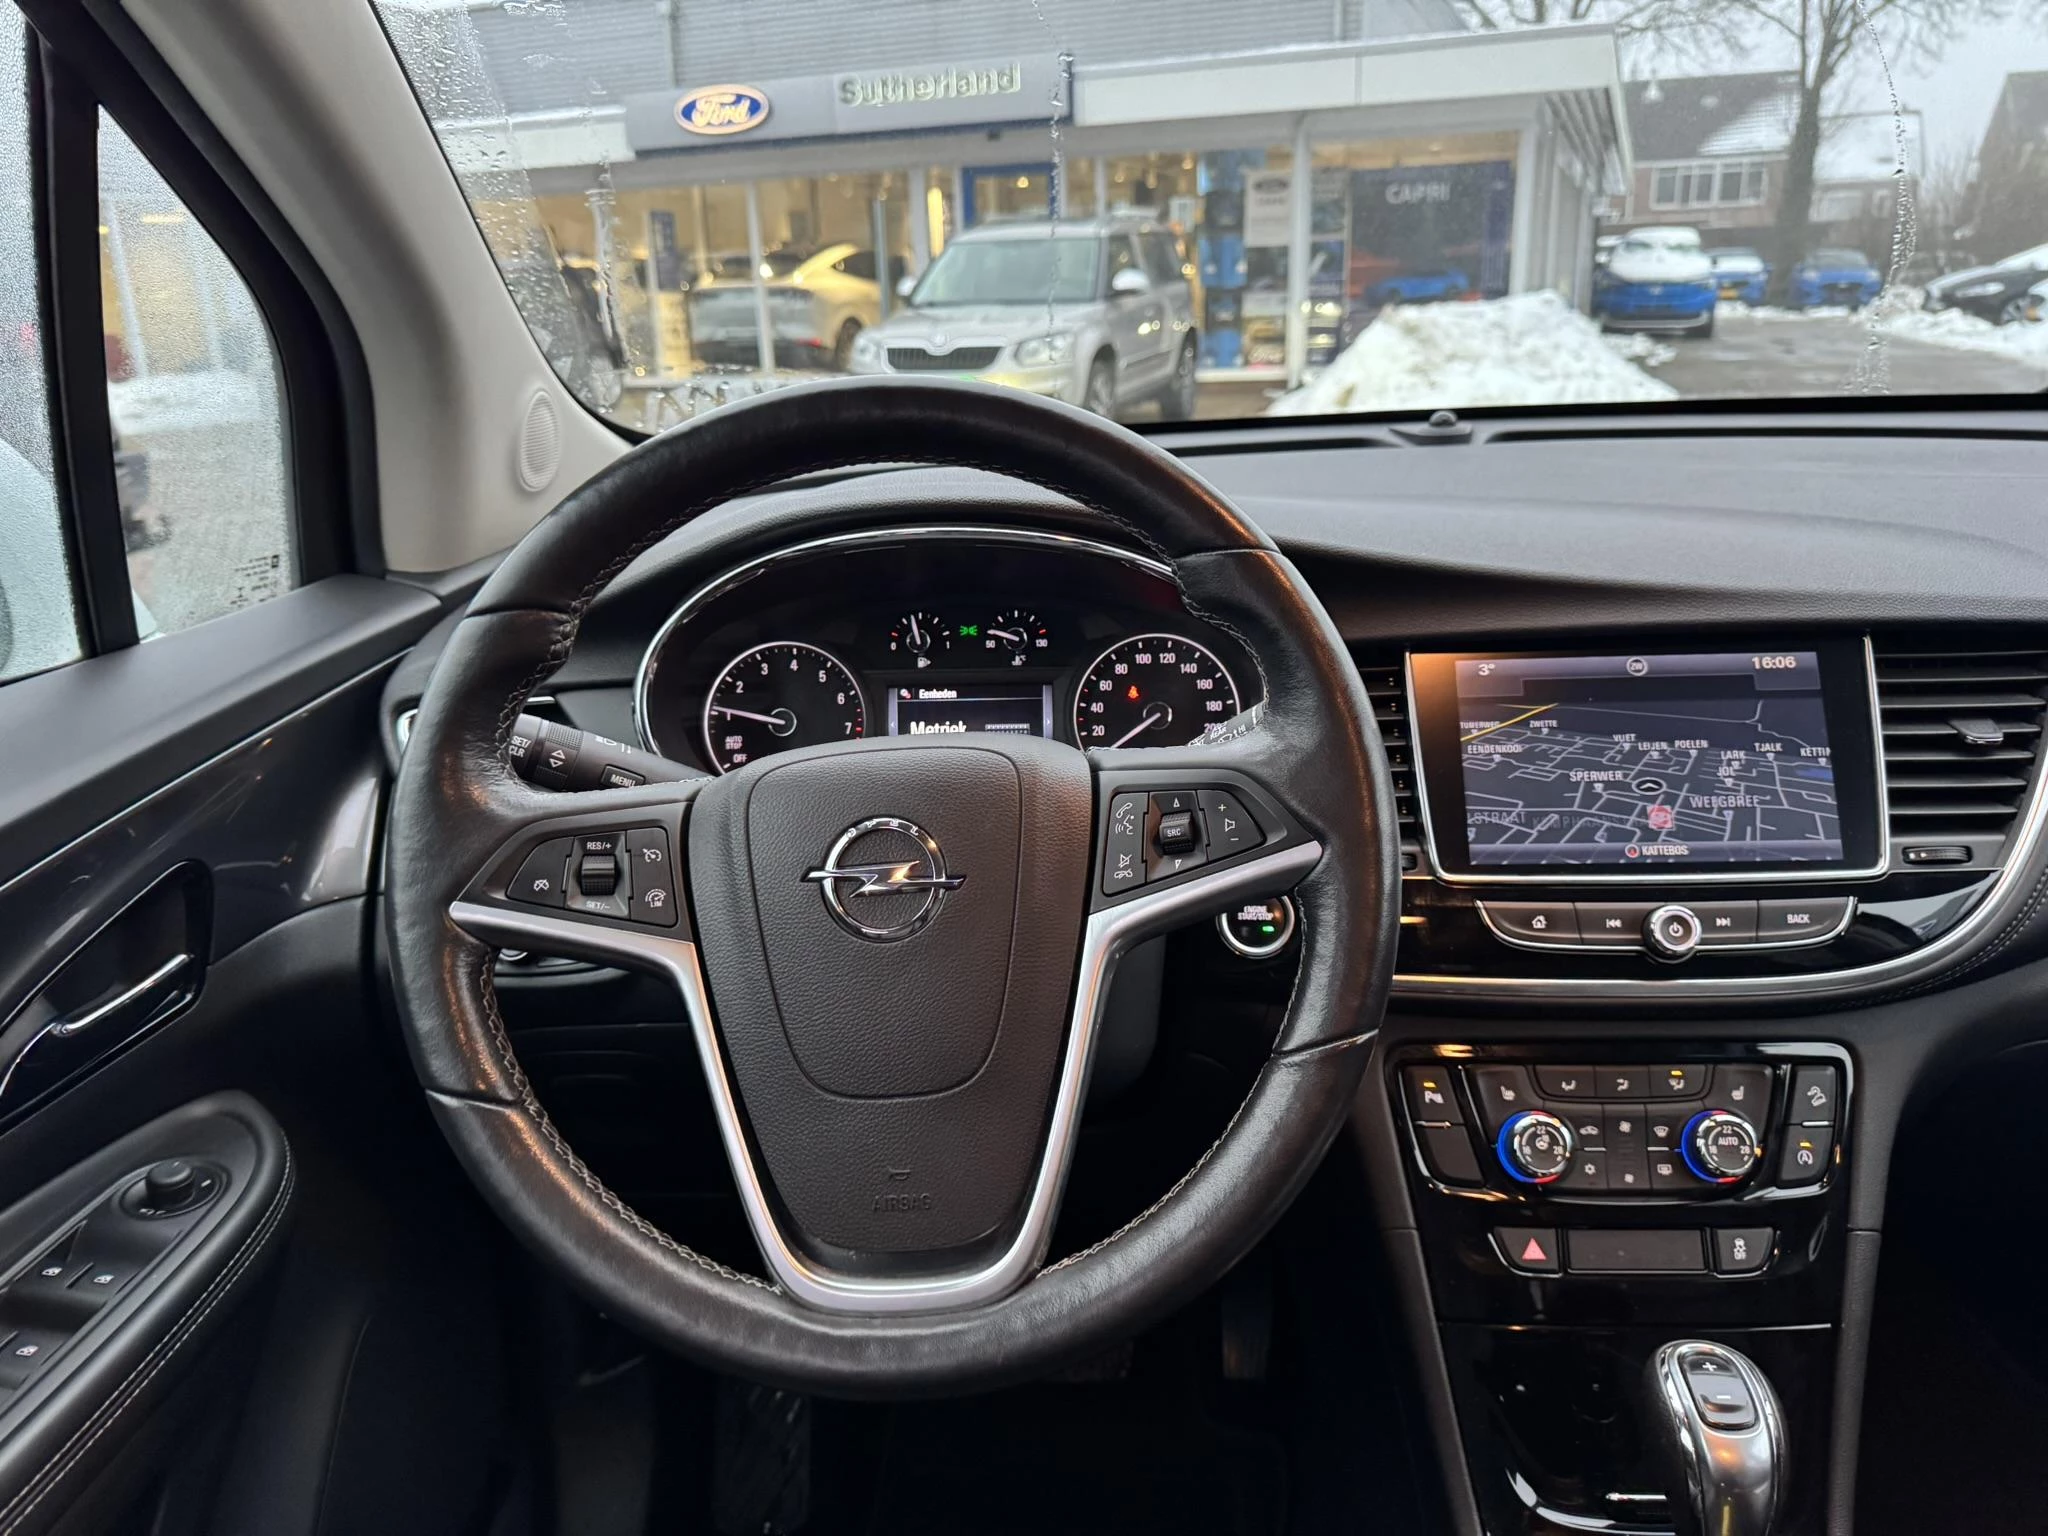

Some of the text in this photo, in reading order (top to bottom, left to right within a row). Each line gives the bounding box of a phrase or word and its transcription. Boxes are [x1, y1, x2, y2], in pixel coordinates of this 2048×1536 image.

[841, 60, 1021, 107] Sutherland
[691, 94, 751, 128] Ford
[891, 642, 897, 650] 0
[985, 640, 996, 649] 50
[1035, 638, 1048, 648] 130
[1135, 654, 1151, 664] 100
[1159, 653, 1176, 664] 120
[1751, 656, 1796, 669] 16:06
[761, 663, 769, 675] 3
[790, 659, 798, 671] 4
[1115, 663, 1128, 674] 80
[1180, 663, 1197, 674] 140
[819, 670, 827, 682] 5
[736, 681, 744, 693] 2
[1100, 680, 1112, 691] 60
[1196, 679, 1213, 690] 160
[837, 693, 845, 704] 6
[919, 688, 957, 699] Eenheden
[1091, 703, 1104, 713] 40
[1206, 701, 1223, 711] 180
[845, 722, 853, 735] 7
[1529, 720, 1558, 728] ZWETTE
[1092, 725, 1105, 736] 20
[512, 735, 531, 747] SET/
[1675, 740, 1708, 749] POELEN
[1754, 742, 1782, 751] TJALK
[509, 746, 525, 758] CLR
[1720, 751, 1745, 760] LARK
[733, 754, 748, 763] OFF
[1569, 771, 1624, 783] SPERWER
[1717, 767, 1734, 777] JOL
[1689, 795, 1760, 808] WEEGBREE
[1167, 829, 1182, 837] SRC
[586, 841, 612, 850] RES/+
[1641, 844, 1689, 856] KATTEBOS
[650, 899, 662, 907] LIM
[1787, 913, 1809, 924] BACK
[1536, 1125, 1546, 1134] 22
[1722, 1125, 1733, 1134] 22
[1718, 1136, 1739, 1146] AUTO
